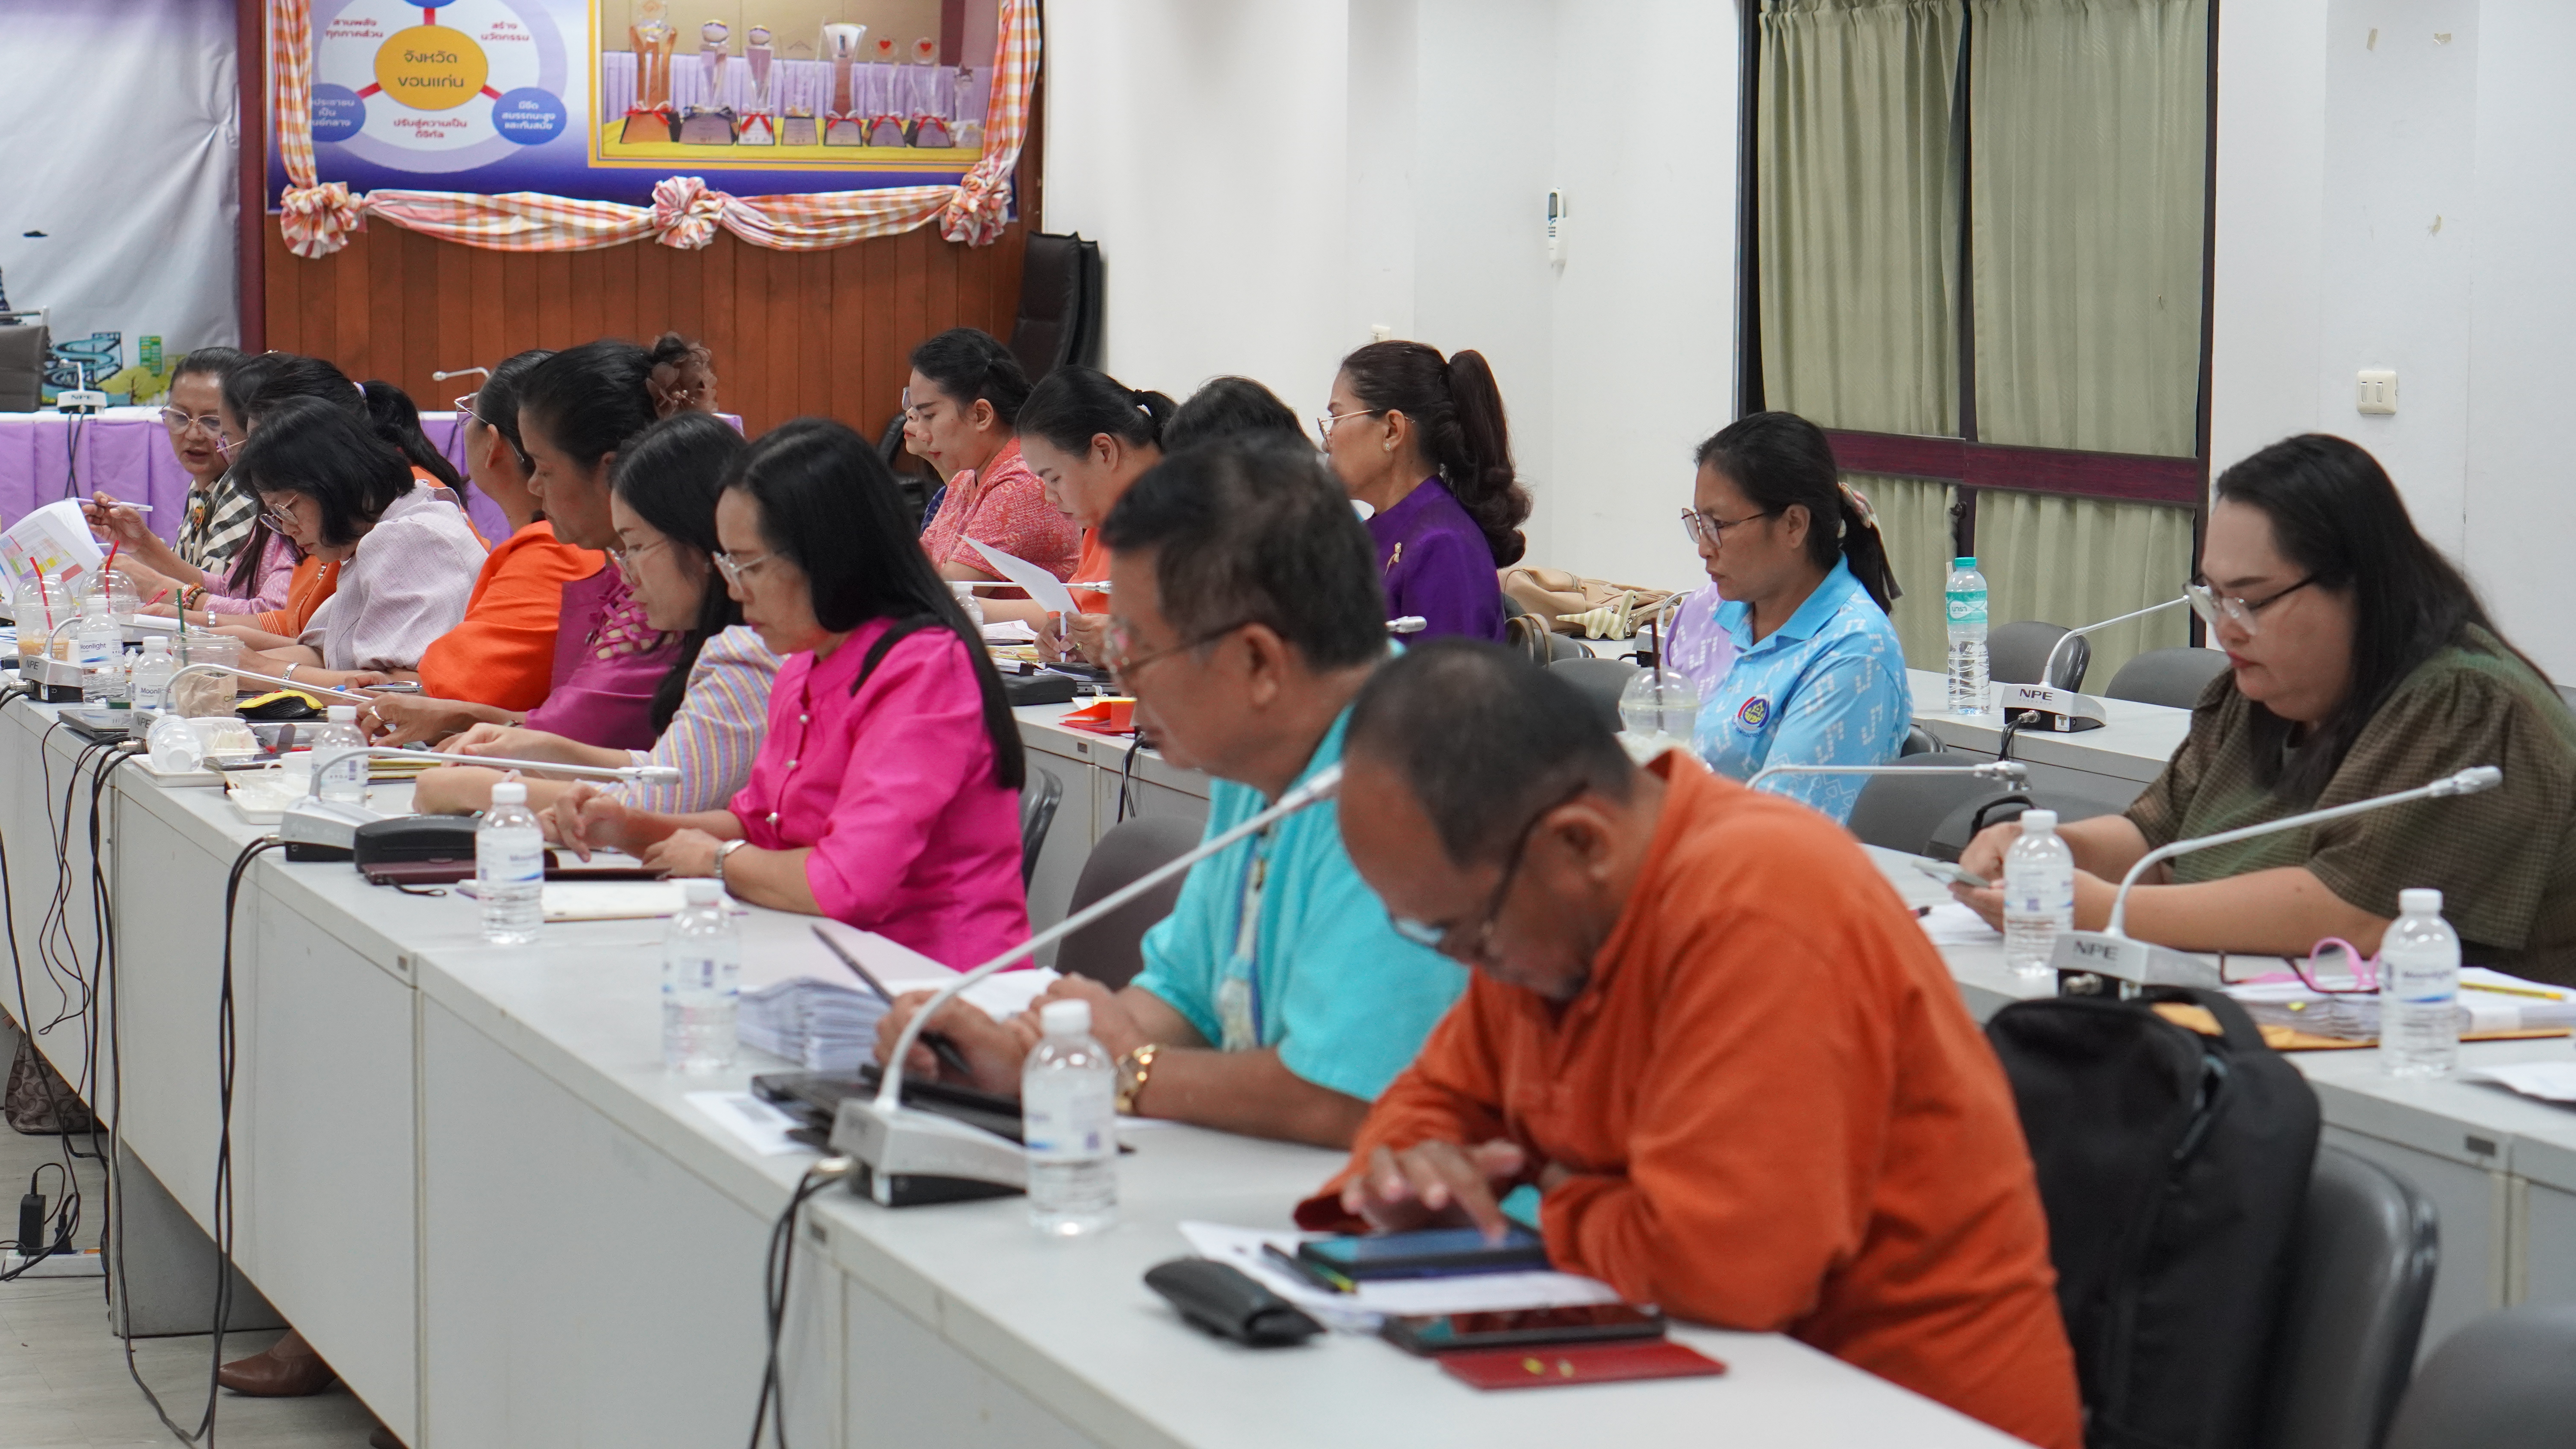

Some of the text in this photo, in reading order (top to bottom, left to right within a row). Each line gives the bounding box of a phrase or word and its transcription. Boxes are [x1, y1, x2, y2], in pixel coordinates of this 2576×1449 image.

[404, 50, 457, 63] จังหวัด
[398, 74, 464, 88] ขอนแก่น
[26, 660, 39, 670] NPE
[2020, 688, 2054, 701] NPE
[2073, 940, 2118, 961] NPE
